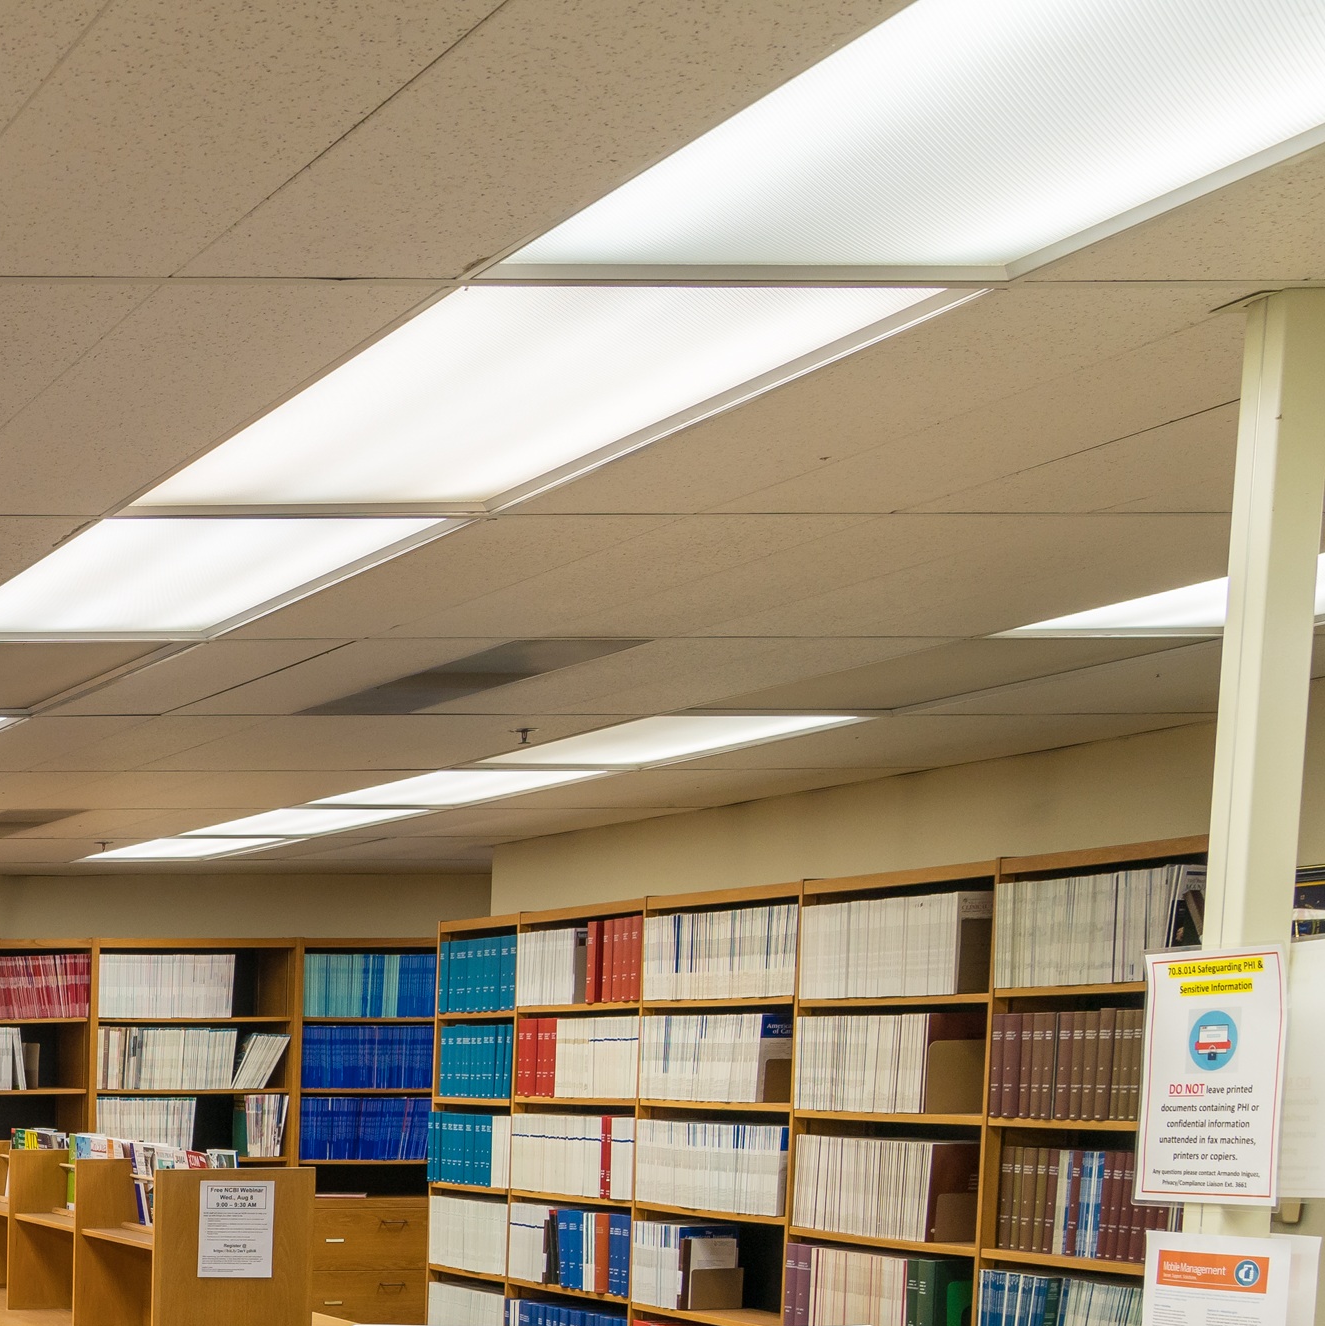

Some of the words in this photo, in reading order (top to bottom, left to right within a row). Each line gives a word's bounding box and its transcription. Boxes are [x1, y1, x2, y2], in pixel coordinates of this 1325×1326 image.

[1168, 966, 1196, 976] 70.8.014
[1197, 963, 1242, 975] Safeguarding
[1243, 961, 1255, 970] PHI
[1257, 960, 1264, 969] &
[1179, 984, 1209, 995] Sensitive
[1211, 981, 1253, 992] Information
[1169, 1084, 1183, 1095] DO
[1185, 1083, 1205, 1095] NOT
[1206, 1085, 1225, 1094] leave
[1226, 1085, 1253, 1095] printed
[1161, 1104, 1197, 1112] documents
[1198, 1103, 1236, 1114] containing
[1237, 1103, 1250, 1112] PHI
[1166, 1119, 1206, 1128] confidential
[1207, 1119, 1250, 1129] information
[1159, 1135, 1198, 1144] unattended
[1199, 1136, 1206, 1144] in
[1207, 1135, 1218, 1144] fax
[1219, 1136, 1256, 1146] machines,
[1173, 1151, 1199, 1161] printers
[1210, 1152, 1238, 1162] copiers.
[1162, 1179, 1205, 1187] Privacy/Compliance
[1163, 1261, 1180, 1272] Mobile
[1180, 1263, 1227, 1276] Management
